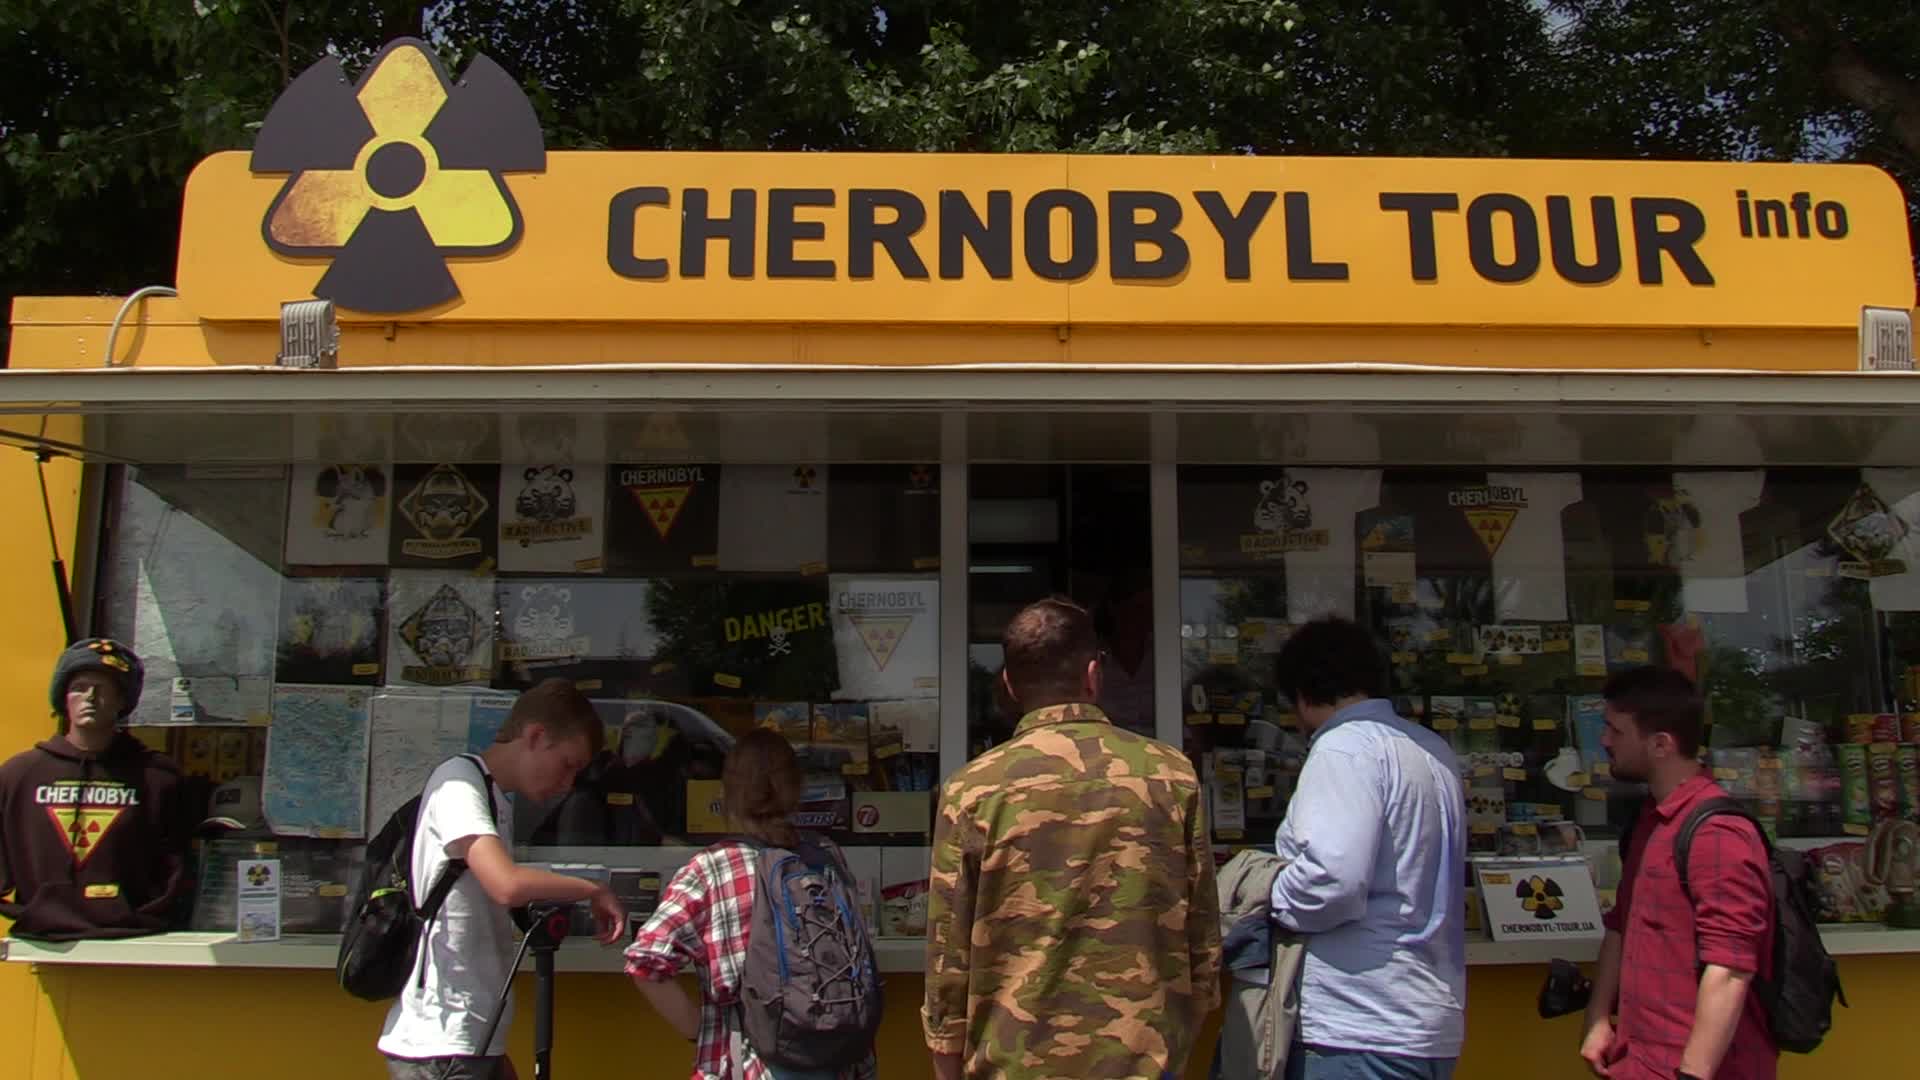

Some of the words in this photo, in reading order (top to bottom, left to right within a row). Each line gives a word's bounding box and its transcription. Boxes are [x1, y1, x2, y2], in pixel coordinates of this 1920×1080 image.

[607, 187, 1349, 281] CHERNOBYL
[1379, 192, 1715, 286] TOUR
[1735, 189, 1849, 239] info
[620, 467, 704, 486] CHERNOBYL
[838, 591, 927, 608] CHERNOBYL
[724, 602, 825, 642] DANGER
[36, 785, 139, 804] CHERNOBYL
